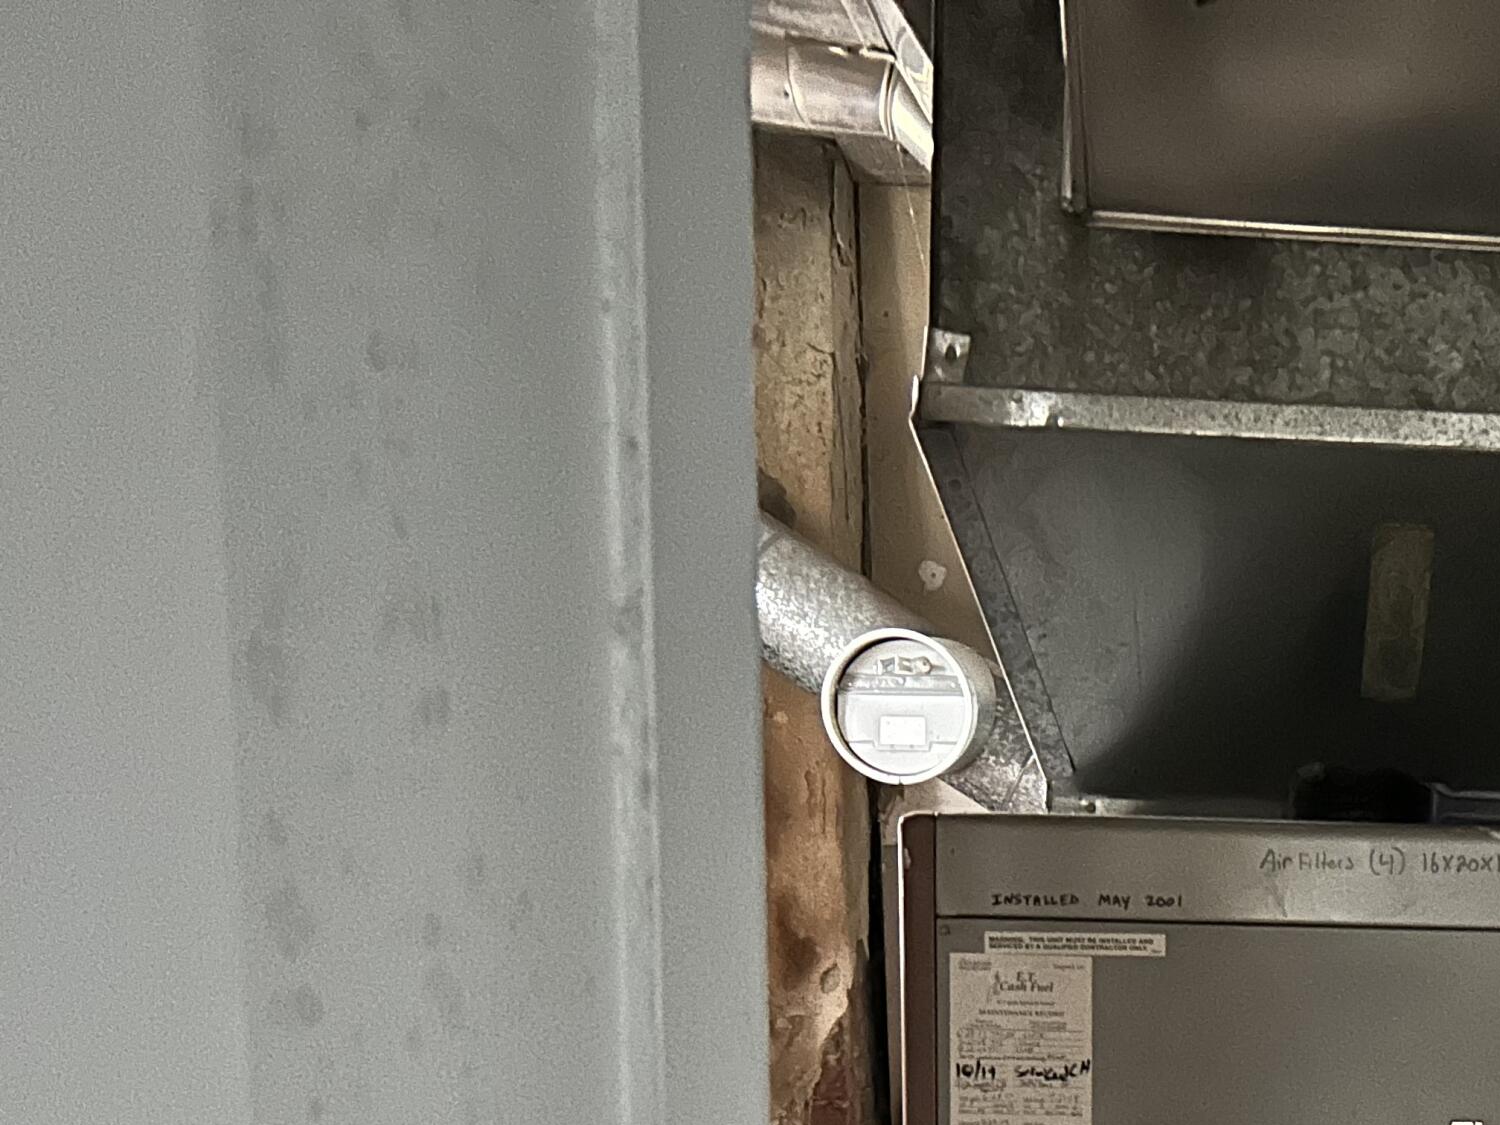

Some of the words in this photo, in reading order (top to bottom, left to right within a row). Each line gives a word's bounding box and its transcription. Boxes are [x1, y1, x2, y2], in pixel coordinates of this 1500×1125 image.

[1259, 849, 1293, 873] Air
[1369, 846, 1406, 876] (4)
[991, 892, 1080, 906] INSTALLED
[1098, 893, 1132, 911] MAY
[1144, 894, 1182, 908] 2001
[1065, 936, 1086, 944] MUST
